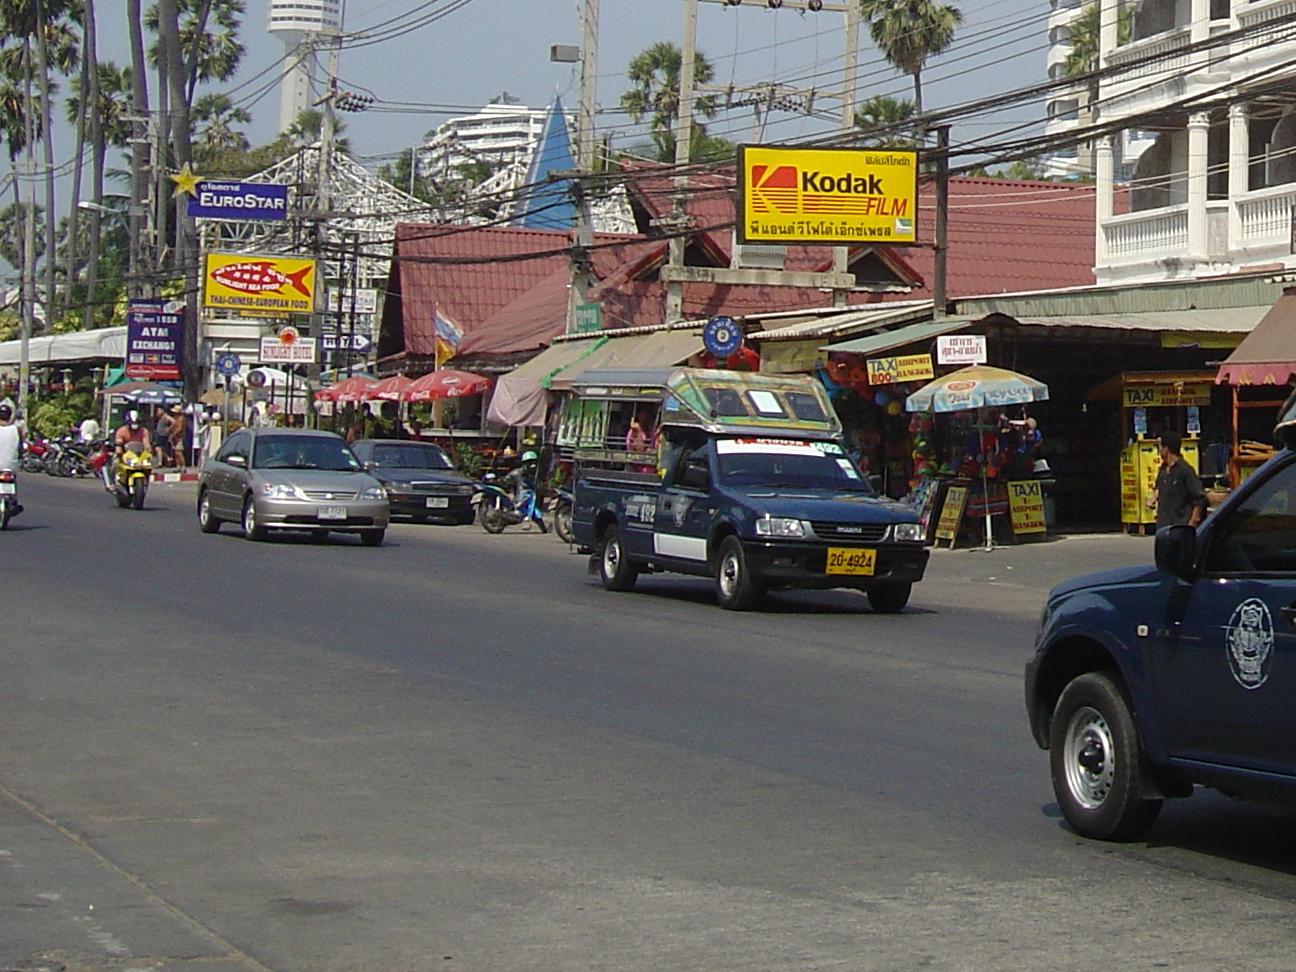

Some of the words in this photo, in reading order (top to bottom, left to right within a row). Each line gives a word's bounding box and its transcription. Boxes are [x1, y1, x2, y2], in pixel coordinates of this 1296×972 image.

[802, 171, 884, 195] Kodak
[866, 197, 908, 216] FILM
[141, 327, 169, 337] ATM
[294, 347, 313, 359] HOTEL
[871, 372, 892, 385] 800
[1126, 389, 1154, 402] TAXI
[1011, 483, 1039, 497] TAXI
[829, 554, 872, 568] 20-4924
